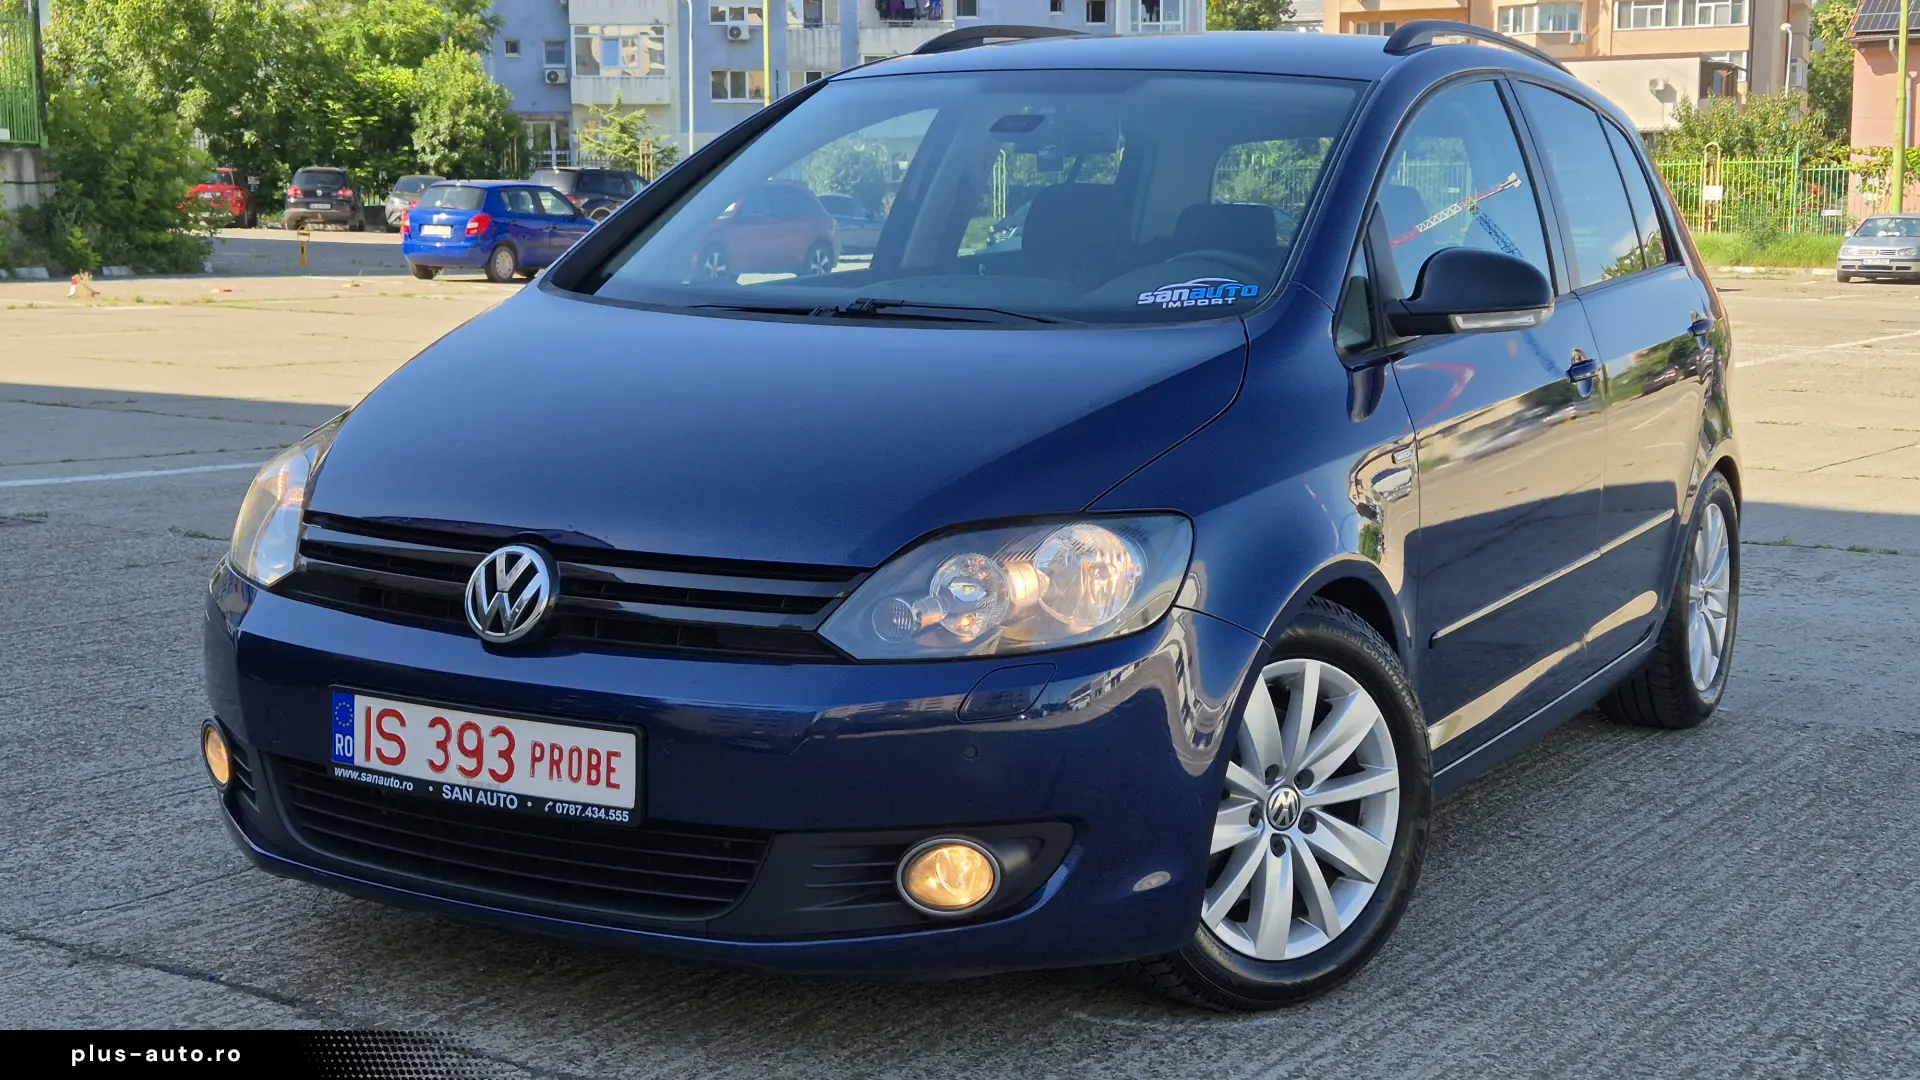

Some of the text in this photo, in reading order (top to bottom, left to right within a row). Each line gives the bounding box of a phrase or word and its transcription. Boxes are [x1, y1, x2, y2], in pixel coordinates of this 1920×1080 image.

[1162, 297, 1236, 308] IMPORT
[1363, 641, 1406, 690] Control
[335, 733, 353, 757] RO
[364, 705, 621, 790] IS 393 PROBE
[334, 767, 414, 791] www.sanauto.ro
[442, 784, 473, 803] SAN
[476, 790, 518, 810] AUTO
[555, 802, 629, 822] 0787.434.555
